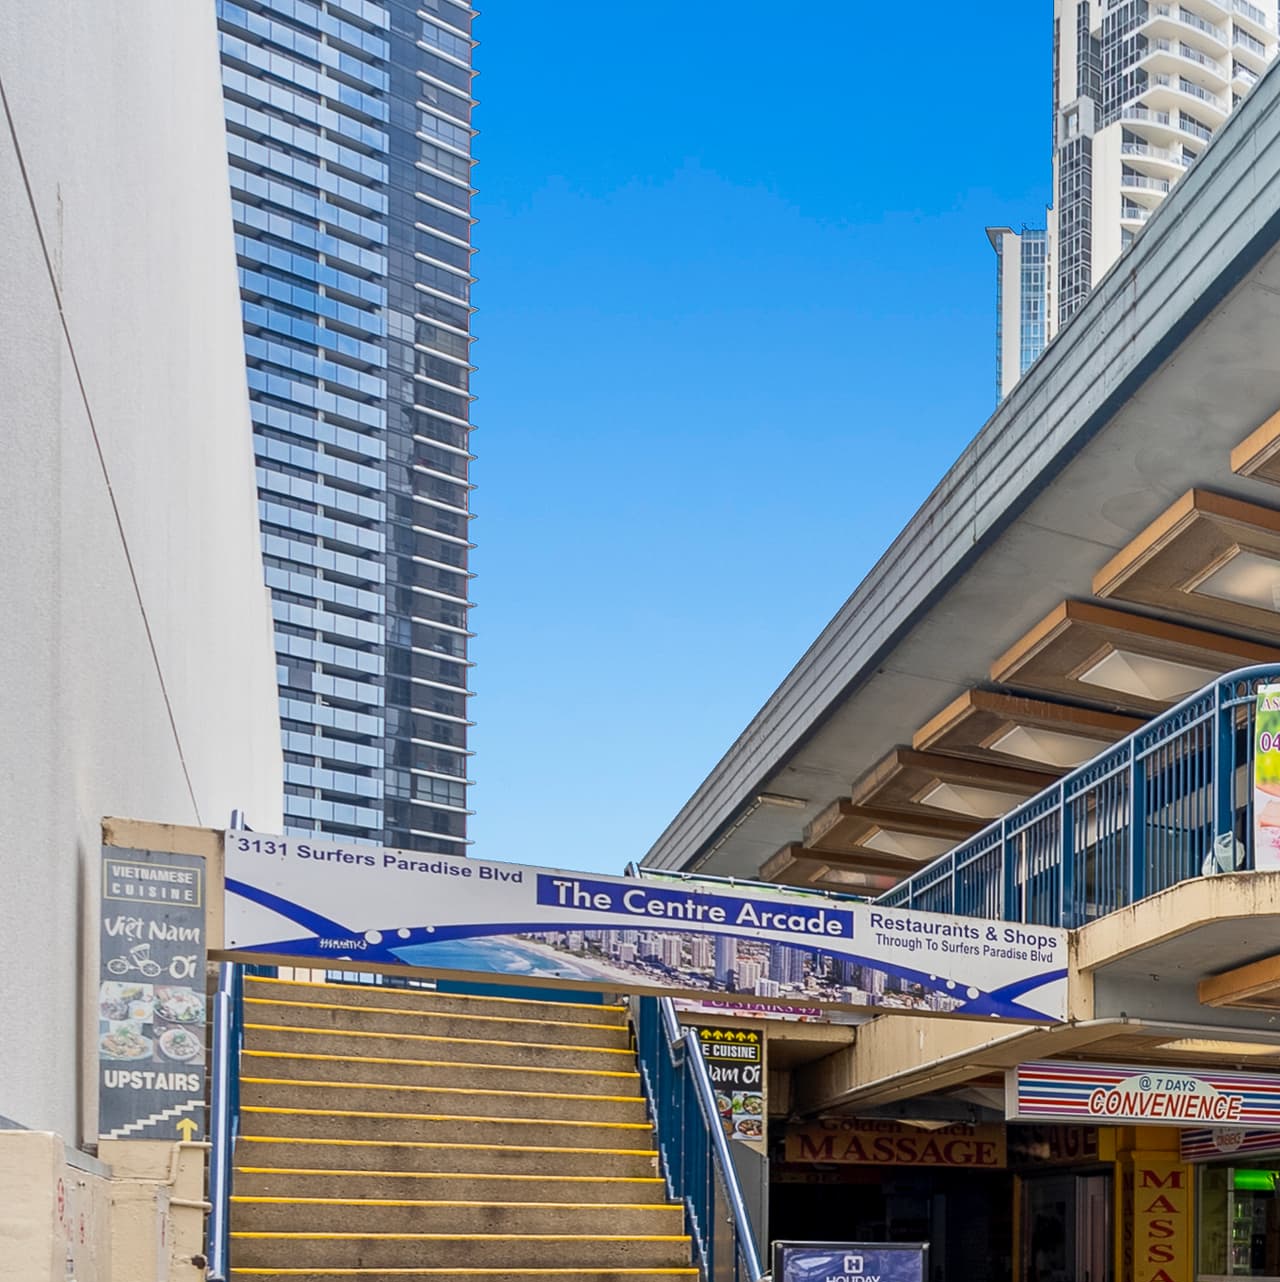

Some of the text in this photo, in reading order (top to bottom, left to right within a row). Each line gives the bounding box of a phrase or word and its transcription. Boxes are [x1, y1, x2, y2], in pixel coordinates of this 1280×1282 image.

[112, 865, 193, 884] VIETNAMESE
[238, 838, 524, 884] 3131 Surfers Paradise Blvd
[112, 883, 193, 901] CUISINE
[552, 879, 844, 936] The Centre Arcade
[104, 916, 200, 944] Việt Nam
[870, 912, 1058, 948] Restaurants & Shops
[875, 932, 1054, 963] Through To Surfers Paradise Blvd
[713, 1044, 756, 1060] CUISINE
[104, 1070, 200, 1091] UPSTAIRS
[1139, 1076, 1196, 1092] @ 7 DAYS
[1089, 1089, 1242, 1120] CONVENIENCE
[799, 1134, 998, 1165] MASSAGE
